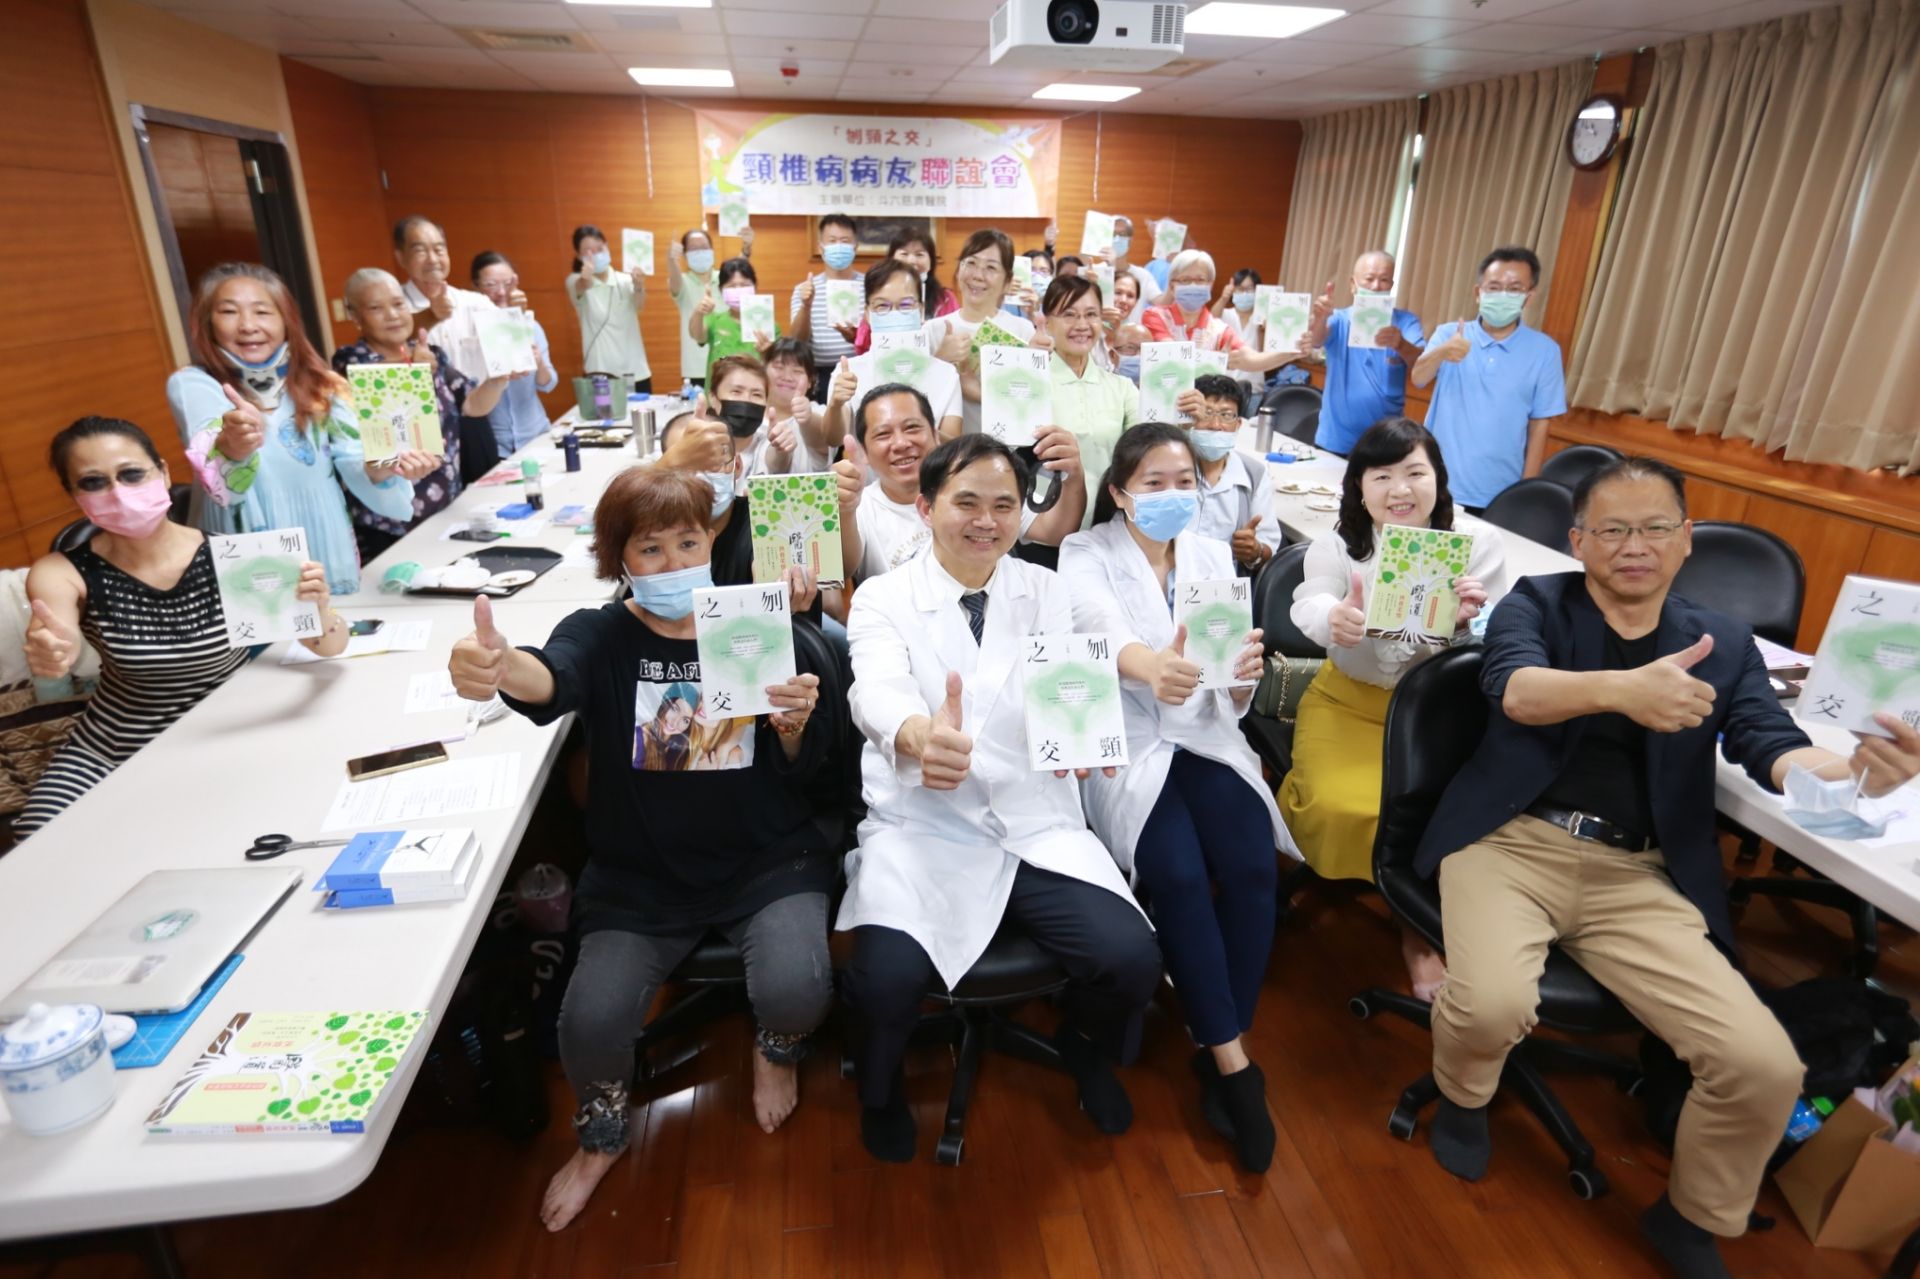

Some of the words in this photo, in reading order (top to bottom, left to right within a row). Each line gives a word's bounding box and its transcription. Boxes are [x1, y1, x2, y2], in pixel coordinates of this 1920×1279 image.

[743, 153, 1020, 187] 頸椎病病友聯誼會
[879, 335, 890, 349] 之
[1181, 344, 1193, 360] 刎
[989, 348, 1004, 366] 之
[1032, 353, 1046, 370] 刎
[1146, 347, 1159, 362] 之
[1146, 408, 1157, 422] 交
[992, 421, 1006, 440] 交
[219, 540, 241, 559] 之
[233, 621, 256, 641] 交
[280, 533, 301, 553] 刎
[293, 613, 316, 633] 頸
[1231, 582, 1247, 601] 刎
[761, 589, 784, 613] 刎
[1184, 585, 1201, 604] 之
[1851, 590, 1884, 617] 之
[700, 597, 722, 619] 之
[1027, 641, 1049, 663] 之
[640, 658, 664, 680] BE
[667, 661, 683, 680] A
[709, 690, 733, 713] 交
[1087, 638, 1109, 661] 刎
[1100, 735, 1122, 759] 頸
[1809, 693, 1845, 719] 交
[1037, 739, 1061, 764] 交
